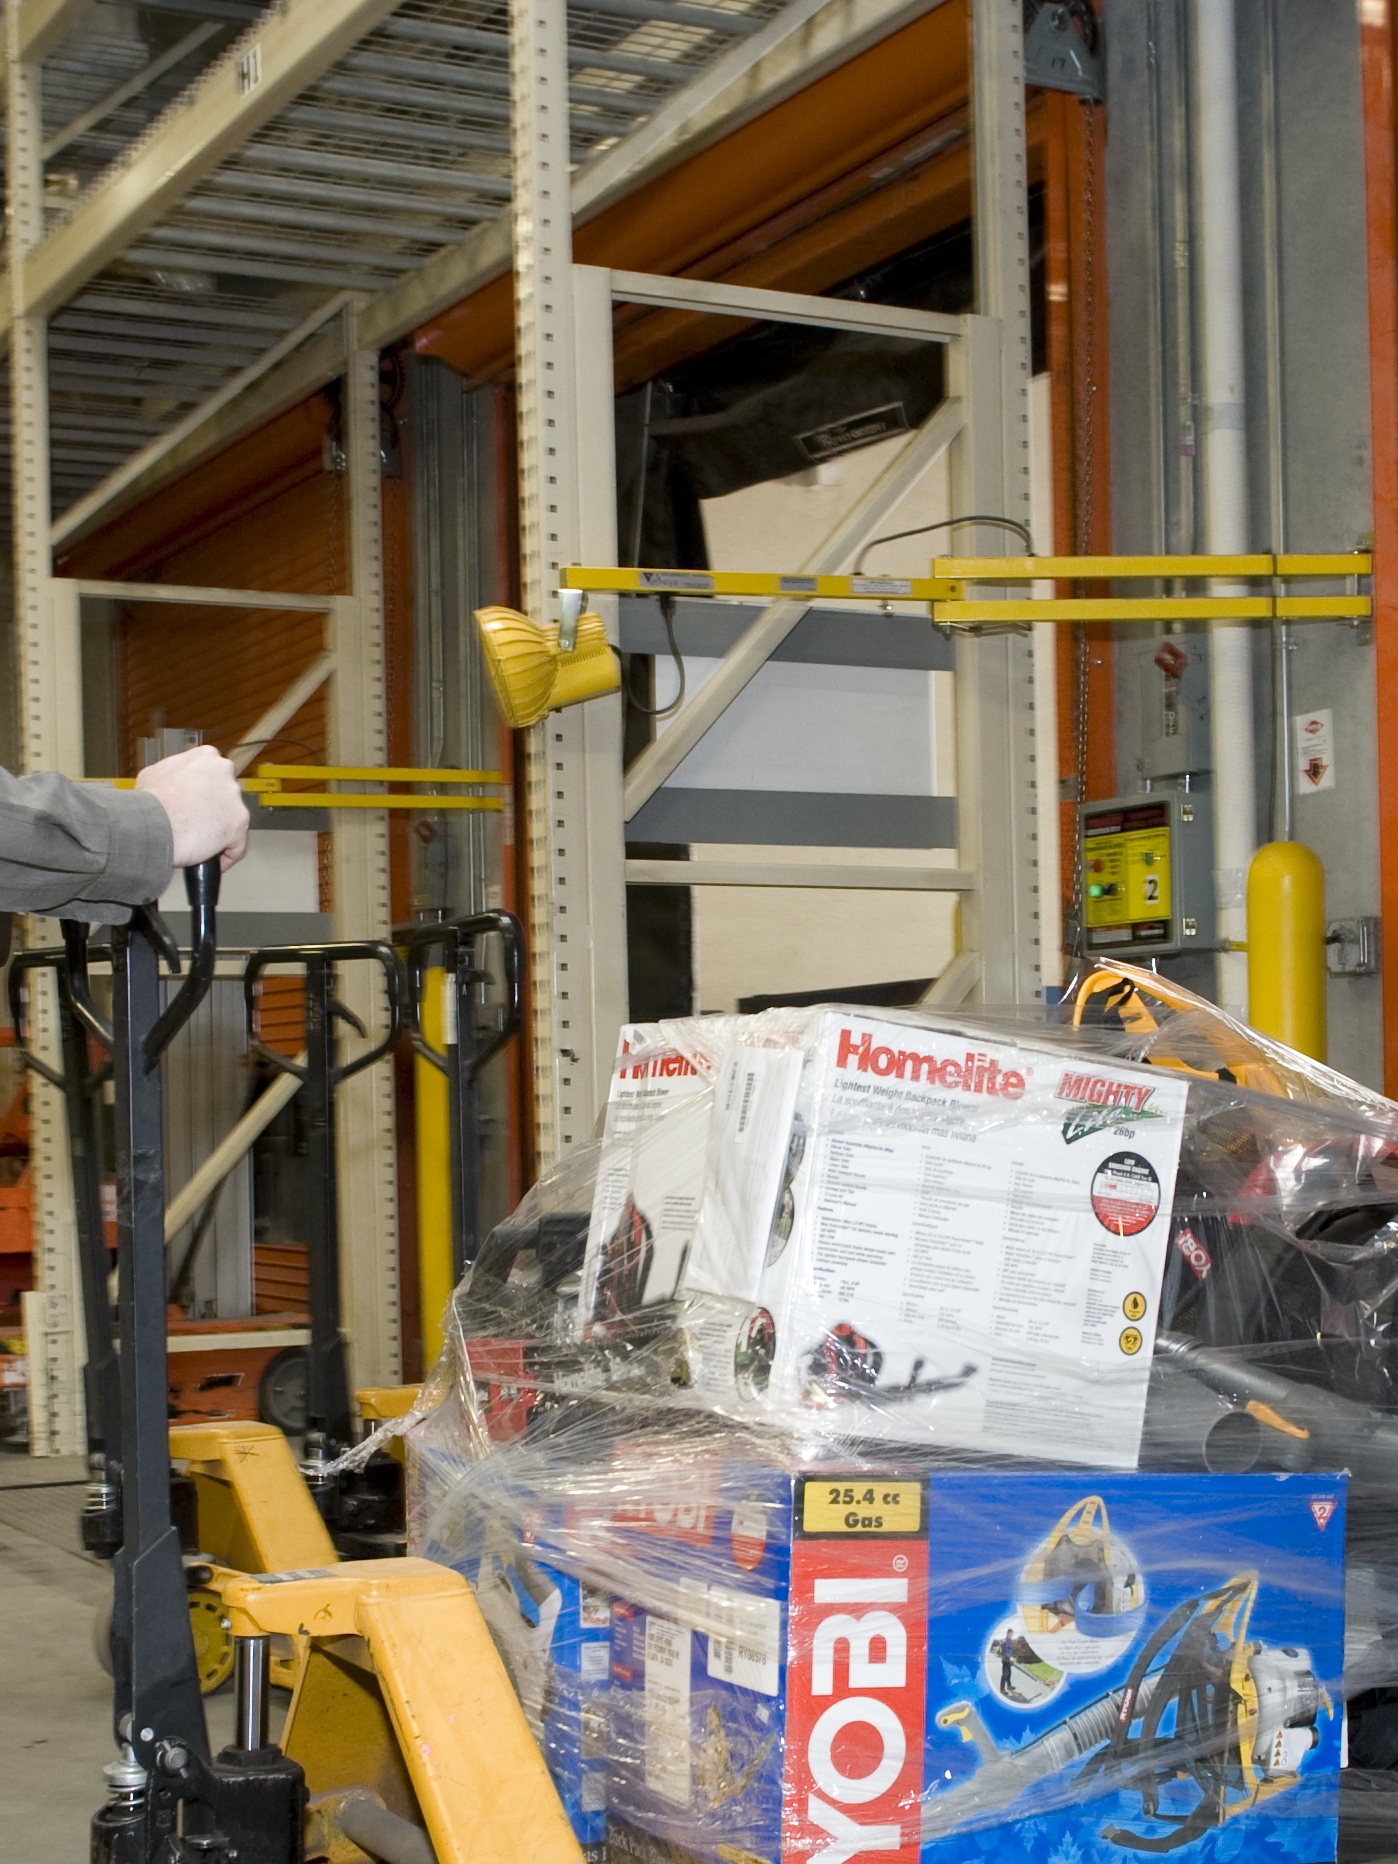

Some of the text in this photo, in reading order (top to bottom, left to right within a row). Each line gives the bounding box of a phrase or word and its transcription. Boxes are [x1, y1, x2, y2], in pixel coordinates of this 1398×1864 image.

[1147, 878, 1159, 901] 2
[835, 1028, 1027, 1101] Homelite
[872, 1085, 904, 1101] Weight
[905, 1091, 947, 1108] Backpack
[1056, 1071, 1154, 1112] MIGHTY
[1113, 1126, 1136, 1140] 26bp
[828, 1488, 901, 1505] 25.4 cc
[843, 1511, 884, 1529] Gas
